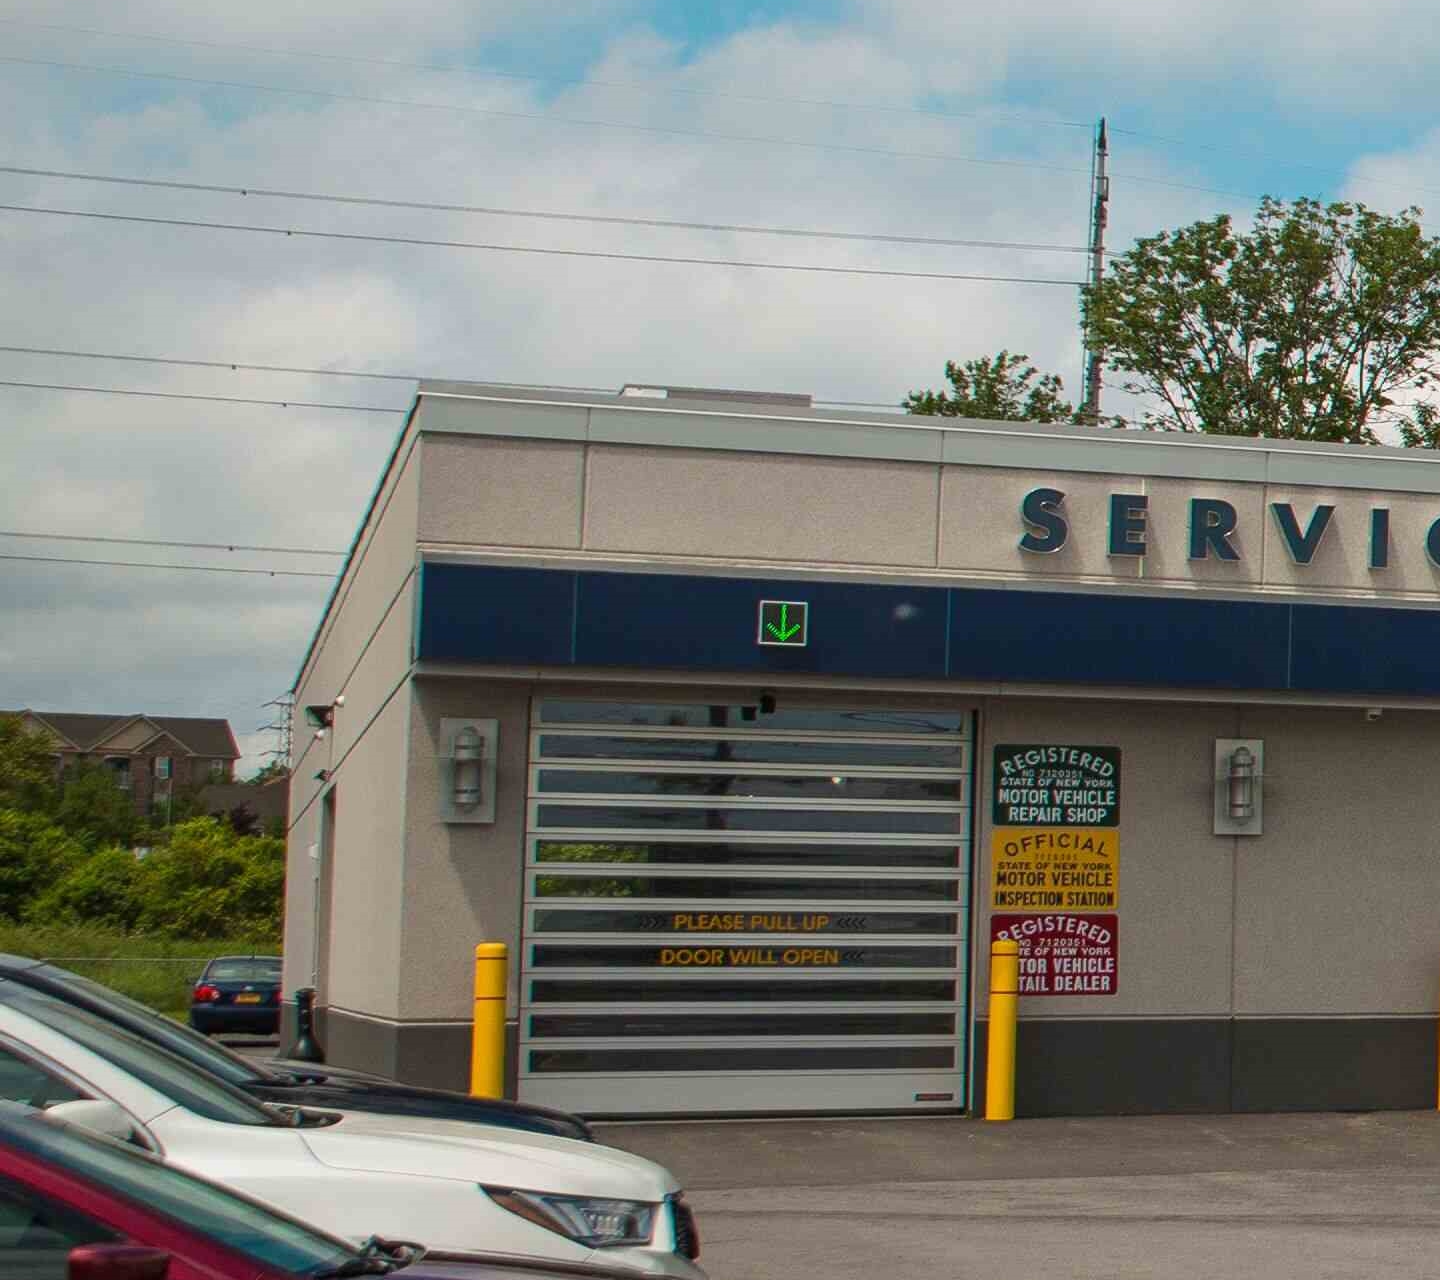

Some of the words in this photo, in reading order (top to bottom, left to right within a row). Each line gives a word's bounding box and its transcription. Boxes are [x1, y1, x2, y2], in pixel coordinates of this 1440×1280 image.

[1000, 747, 1114, 777] REGISTERED
[1000, 777, 1034, 786] STATE
[1038, 778, 1053, 786] OF
[1056, 778, 1081, 787] NEW
[1084, 780, 1114, 788] YORK
[999, 788, 1048, 804] MOTOR
[1053, 790, 1116, 806] VEHICLE
[1008, 806, 1062, 822] REPAIR
[1066, 808, 1108, 823] SHOP
[1004, 833, 1109, 857] OFFICIAL
[997, 862, 1032, 870] STATE
[1035, 862, 1050, 870] OF
[1083, 863, 1113, 871] YORK
[996, 872, 1046, 886] MOTOR
[1051, 872, 1113, 887] VEHICLE
[994, 892, 1063, 906] INSPECTION
[1067, 892, 1115, 906] STATION
[673, 914, 745, 930] PLEASE
[751, 915, 798, 930] PULL
[803, 915, 829, 930] UP
[997, 916, 1111, 944] REGISTERED
[660, 949, 724, 964] DOOR
[730, 949, 778, 964] WILL
[783, 949, 839, 964] OPEN
[1034, 947, 1050, 956] OF
[1053, 947, 1078, 956] NEW
[1082, 947, 1111, 956] YORK
[1019, 958, 1047, 974] TOR
[1053, 958, 1115, 973] VEHICLE
[1018, 975, 1049, 992] TAIL
[1054, 975, 1111, 991] DEALER
